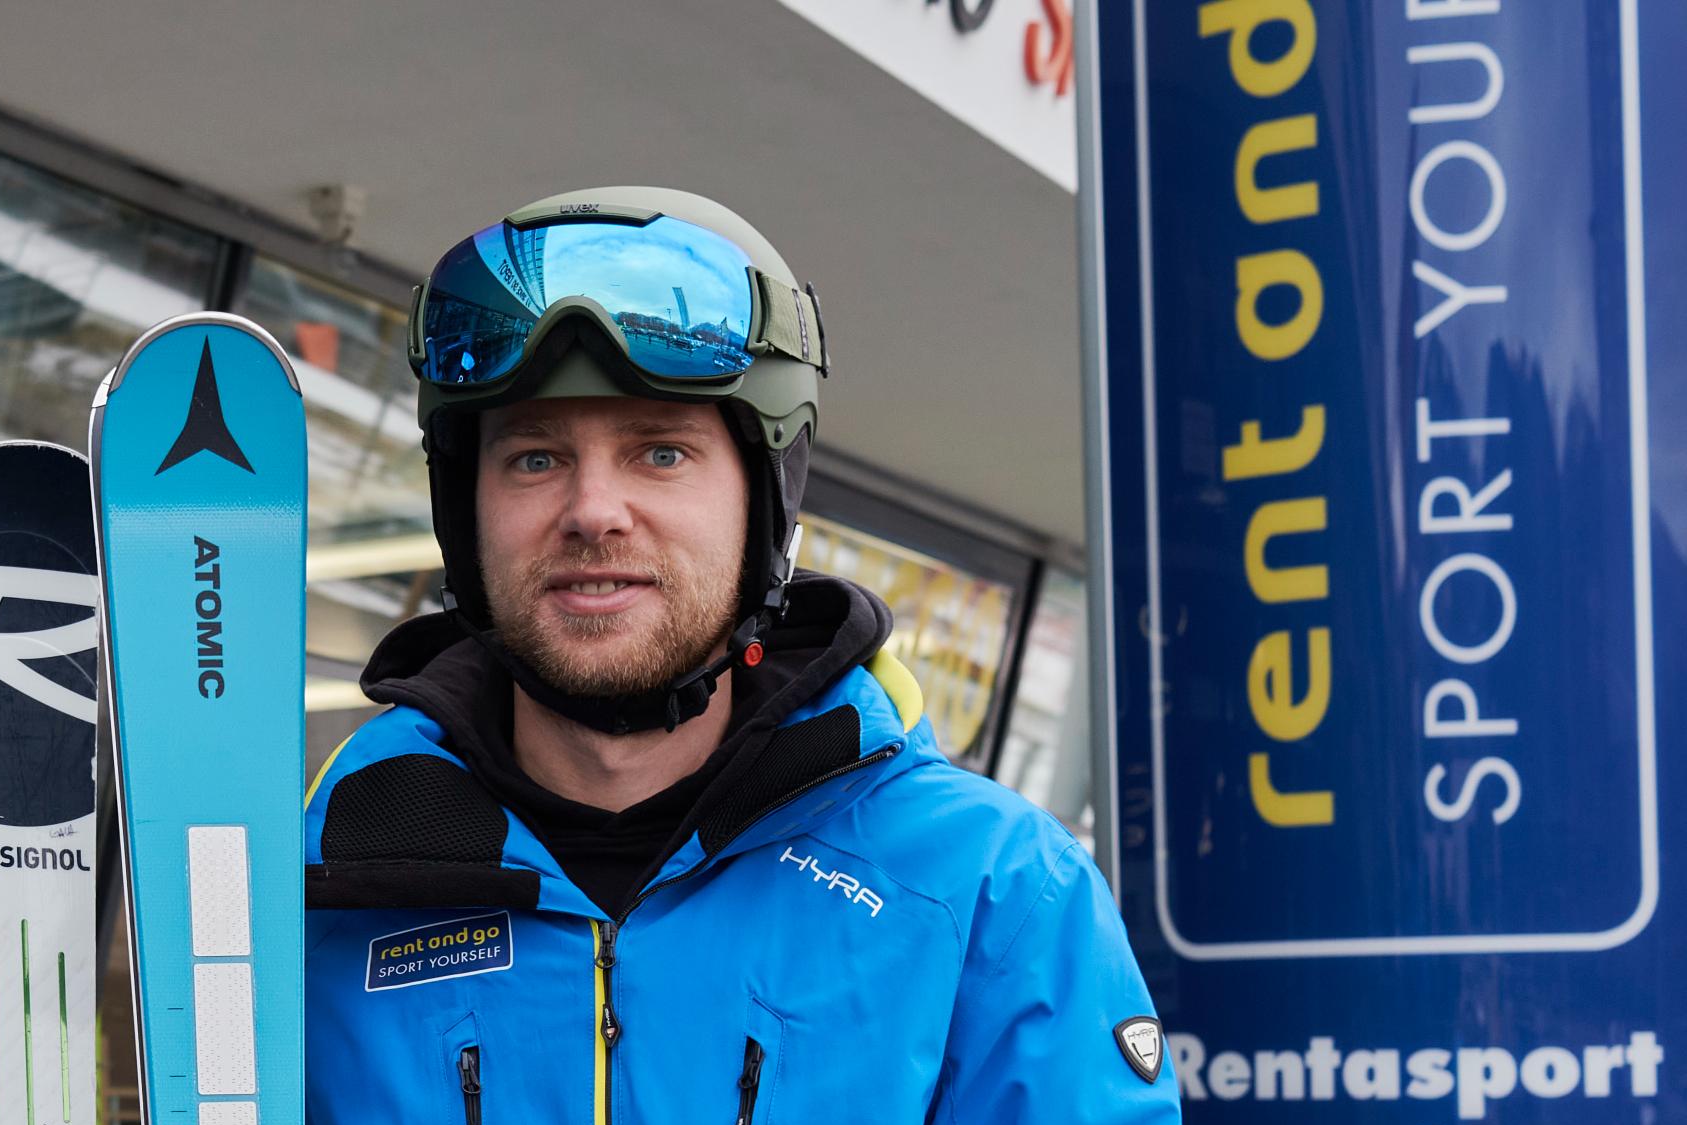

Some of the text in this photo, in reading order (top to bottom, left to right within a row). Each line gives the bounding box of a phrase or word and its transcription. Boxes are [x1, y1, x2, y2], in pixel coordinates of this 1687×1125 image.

[560, 203, 599, 214] uvex
[1197, 0, 1334, 827] rent and
[1405, 0, 1522, 825] SPORT YOU
[193, 535, 225, 700] ATOMIC
[779, 846, 884, 918] HYRA
[378, 945, 501, 978] SPORT YOURSELF
[380, 926, 500, 960] rent and go
[1169, 1031, 1664, 1120] Rentasport
